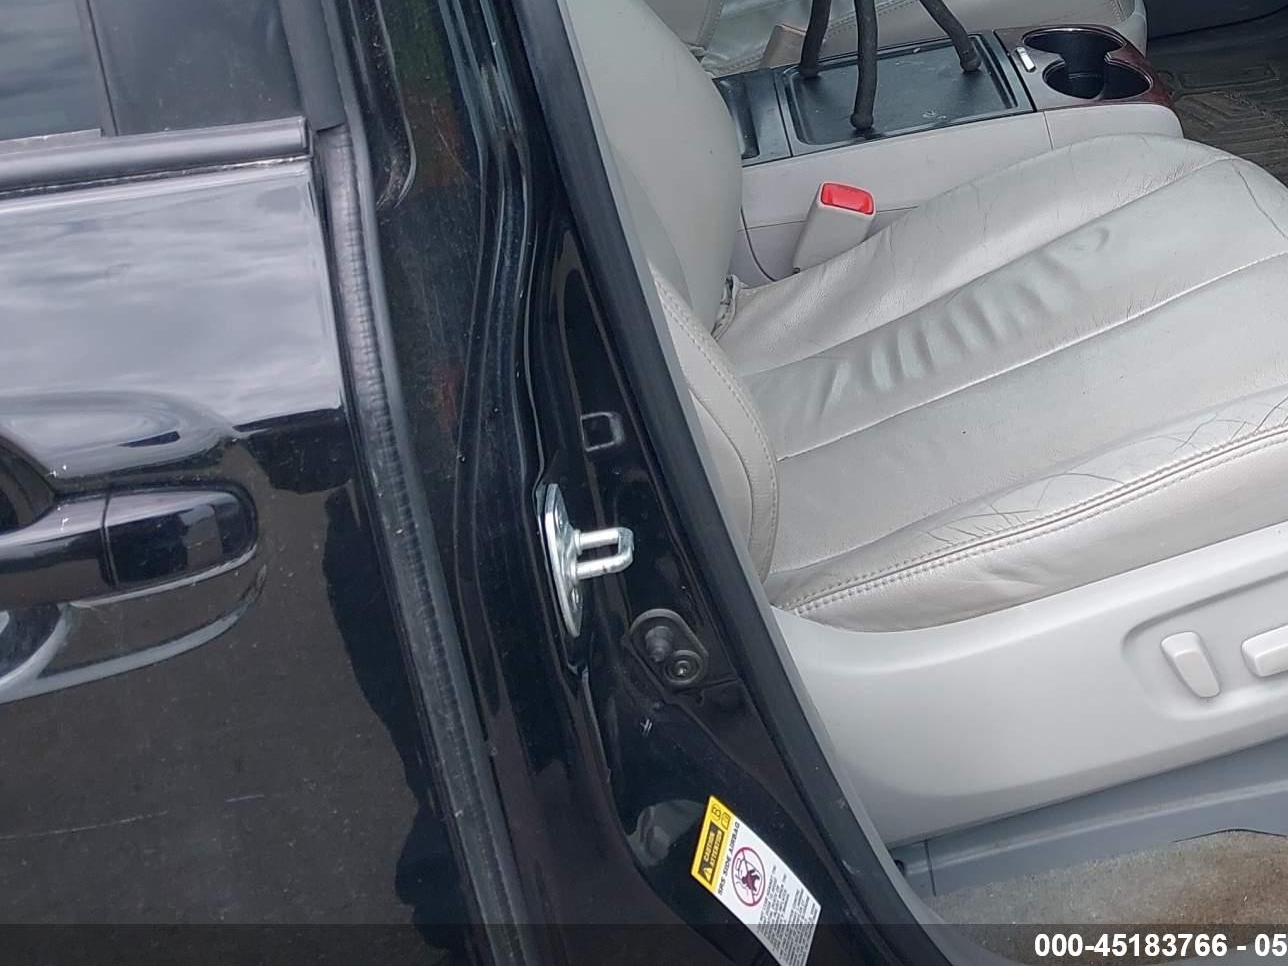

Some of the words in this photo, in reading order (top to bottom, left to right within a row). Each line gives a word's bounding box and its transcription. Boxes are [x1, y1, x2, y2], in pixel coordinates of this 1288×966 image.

[703, 832, 716, 864] CAUTION
[709, 830, 722, 868] ATTENTION
[717, 878, 727, 897] SRS
[722, 854, 731, 878] SIDE
[728, 821, 740, 855] AIRBAG
